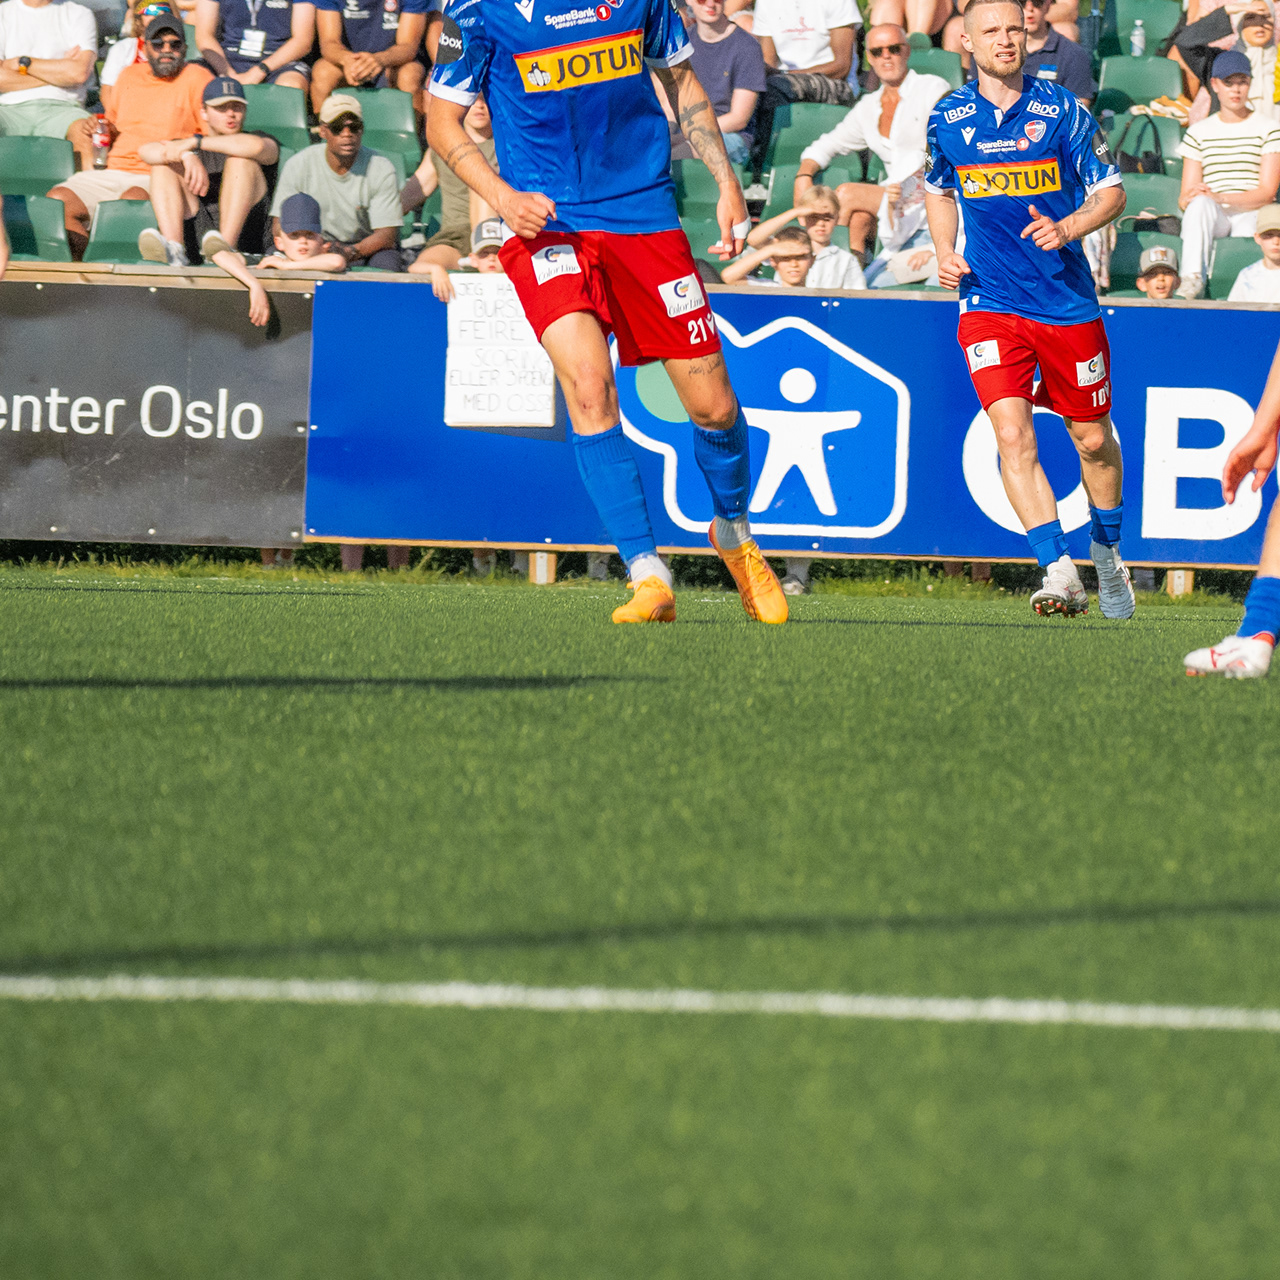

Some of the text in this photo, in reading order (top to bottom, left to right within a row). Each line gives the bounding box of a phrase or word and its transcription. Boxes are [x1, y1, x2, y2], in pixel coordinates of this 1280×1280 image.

[544, 7, 595, 27] SpareBank
[557, 41, 643, 84] JOTUN
[976, 139, 1016, 151] SpareBank
[982, 166, 1057, 192] JOTUN
[459, 320, 525, 341] FEIRE
[687, 318, 708, 345] 21
[0, 384, 263, 440] nter Oslo
[463, 393, 501, 412] MED
